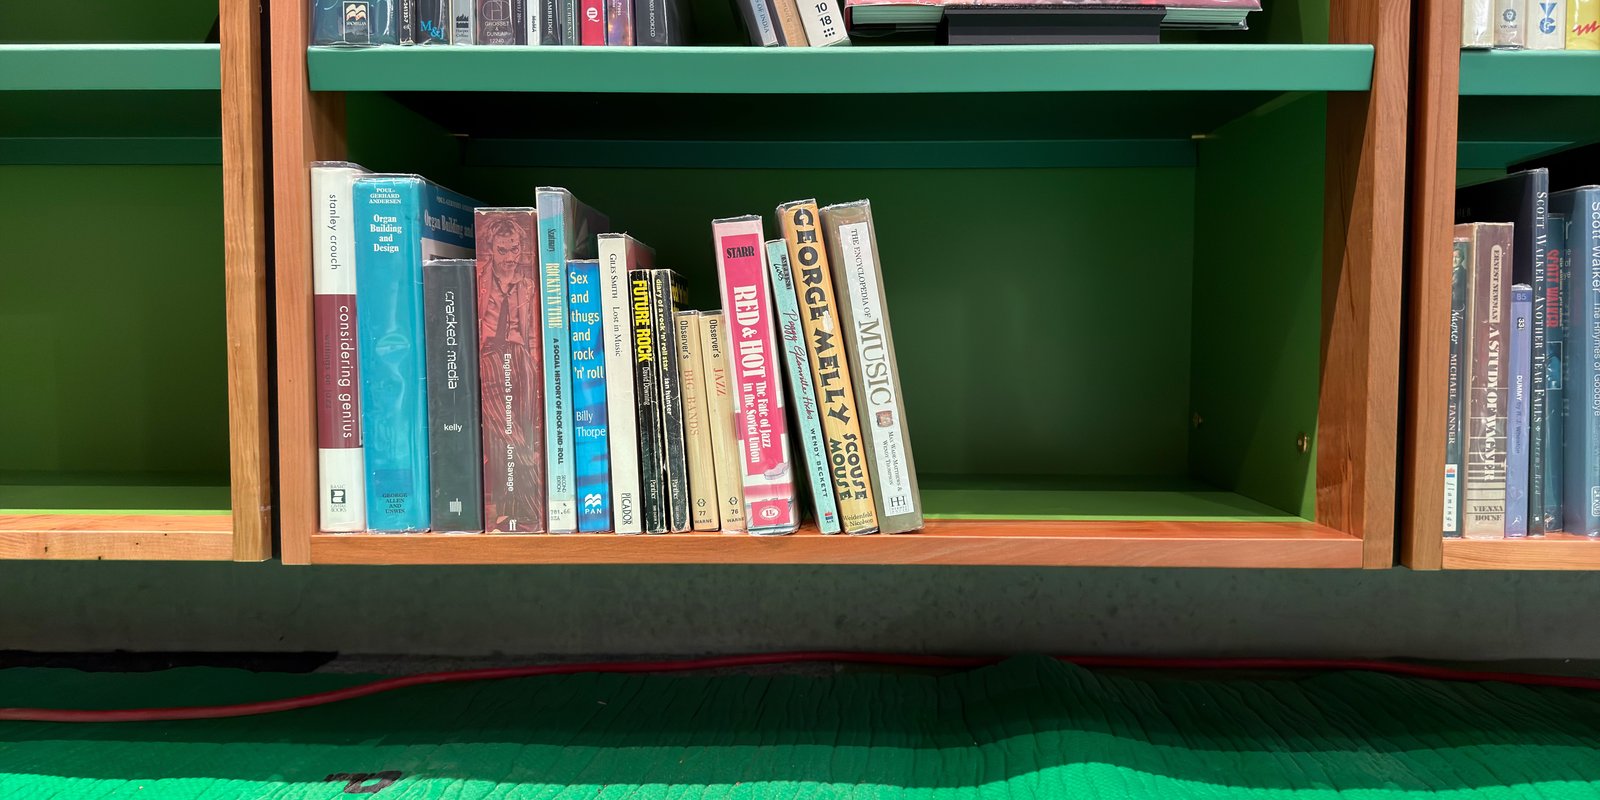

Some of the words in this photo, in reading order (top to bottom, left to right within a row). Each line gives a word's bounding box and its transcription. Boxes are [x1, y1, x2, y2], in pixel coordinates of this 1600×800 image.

[815, 2, 828, 13] 10
[420, 19, 444, 40] M&J
[760, 12, 770, 34] INDIA
[819, 15, 832, 26] 18
[327, 194, 341, 230] stanley
[373, 213, 397, 224] Organ
[1536, 191, 1548, 229] SCOTT
[1592, 201, 1600, 240] Scott
[369, 223, 402, 234] Building
[378, 234, 393, 242] and
[850, 228, 860, 246] THE
[329, 235, 342, 271] crouch
[373, 243, 400, 254] Design
[726, 245, 755, 259] STARR
[1535, 234, 1547, 282] WALKER
[609, 253, 618, 274] GILES
[1547, 249, 1559, 282] SCOTT
[1592, 245, 1600, 294] Walker
[545, 262, 561, 296] ROCKIN'
[569, 271, 589, 285] Sex
[611, 275, 619, 299] SMITH
[655, 278, 663, 298] diary
[853, 247, 869, 306] ENCYCLOPEDIA
[547, 296, 562, 305] IN
[570, 290, 589, 304] and
[632, 280, 650, 326] FUTURE
[658, 299, 664, 307] of
[733, 284, 761, 326] RED
[1491, 283, 1499, 321] NEWMAN
[1546, 286, 1559, 328] WALKER
[445, 291, 458, 346] cracked
[547, 305, 563, 329] TIME
[571, 309, 600, 325] thugs
[612, 306, 621, 323] Lost
[793, 208, 831, 321] GEORGE
[813, 327, 852, 426] MELLY
[863, 306, 872, 319] OF
[1451, 304, 1465, 345] Wagner
[1534, 295, 1546, 348] ANOTHER
[572, 328, 591, 342] and
[614, 324, 621, 332] in
[741, 326, 758, 339] &
[783, 309, 799, 343] Peggy
[1489, 326, 1499, 338] A
[338, 305, 355, 387] considering
[614, 334, 623, 357] Music
[636, 328, 653, 363] ROCK
[680, 320, 691, 360] Observer's
[709, 319, 721, 359] Observer's
[573, 346, 595, 361] rock
[739, 339, 767, 378] HOT
[858, 318, 892, 406] MUSIC
[447, 350, 459, 389] media
[504, 353, 513, 393] England's
[574, 367, 585, 380] 'n'
[587, 365, 605, 379] roll
[1449, 353, 1458, 400] MICHAEL
[1487, 340, 1499, 392] STUDY
[1534, 353, 1546, 383] TEAR
[554, 370, 562, 399] HISTORY
[683, 369, 694, 390] BIG
[713, 368, 727, 396] JAZZ
[742, 383, 754, 392] in
[755, 381, 768, 397] The
[556, 400, 562, 410] OF
[744, 394, 756, 408] the
[757, 398, 770, 417] Fate
[1486, 392, 1498, 412] OF
[1534, 388, 1546, 423] FALLS
[338, 393, 355, 438] genius
[505, 395, 514, 435] Dreaming
[575, 410, 593, 424] Billy
[686, 397, 700, 434] BANDS
[745, 409, 759, 435] Soviet
[759, 418, 771, 429] of
[1448, 403, 1457, 445] TANNER
[443, 423, 463, 433] kelly
[575, 426, 606, 440] Thorpe
[760, 428, 772, 448] Jazz
[887, 431, 896, 443] MAX
[507, 444, 515, 461] Jon
[748, 436, 761, 463] Union
[882, 439, 890, 458] WENDY
[1484, 414, 1497, 481] WAGNER
[810, 428, 820, 457] WENDY
[816, 460, 828, 498] BECKETT
[829, 437, 853, 502] MOUSE
[842, 433, 868, 501] SCOUSE
[506, 462, 515, 492] Savage
[650, 479, 658, 500] Panther
[672, 479, 680, 500] Panther
[621, 492, 633, 526] PICADOR
